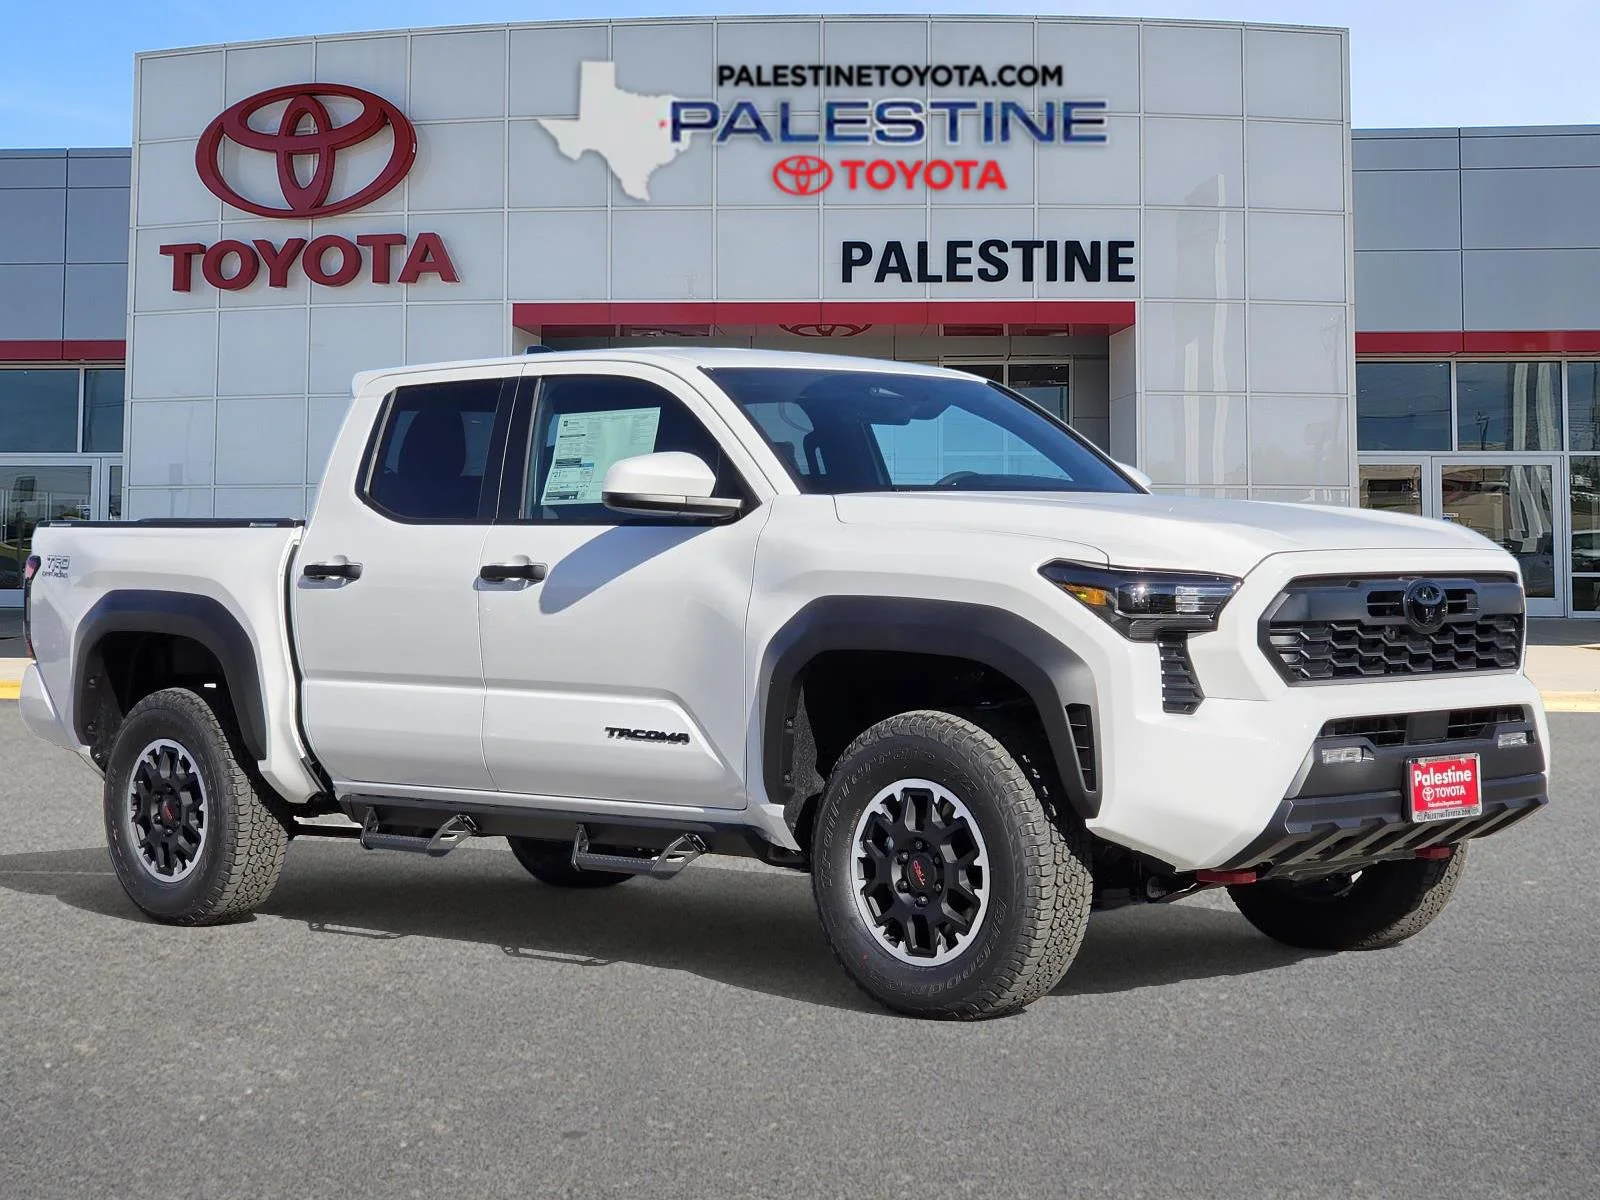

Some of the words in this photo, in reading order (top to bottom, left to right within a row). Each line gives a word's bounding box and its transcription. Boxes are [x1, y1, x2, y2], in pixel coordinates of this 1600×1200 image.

[159, 231, 461, 293] TOYOTA
[841, 239, 1136, 283] PALESTINE
[605, 726, 690, 745] TACOMA
[1414, 766, 1473, 788] Palestine
[1435, 785, 1466, 798] TOYOTA
